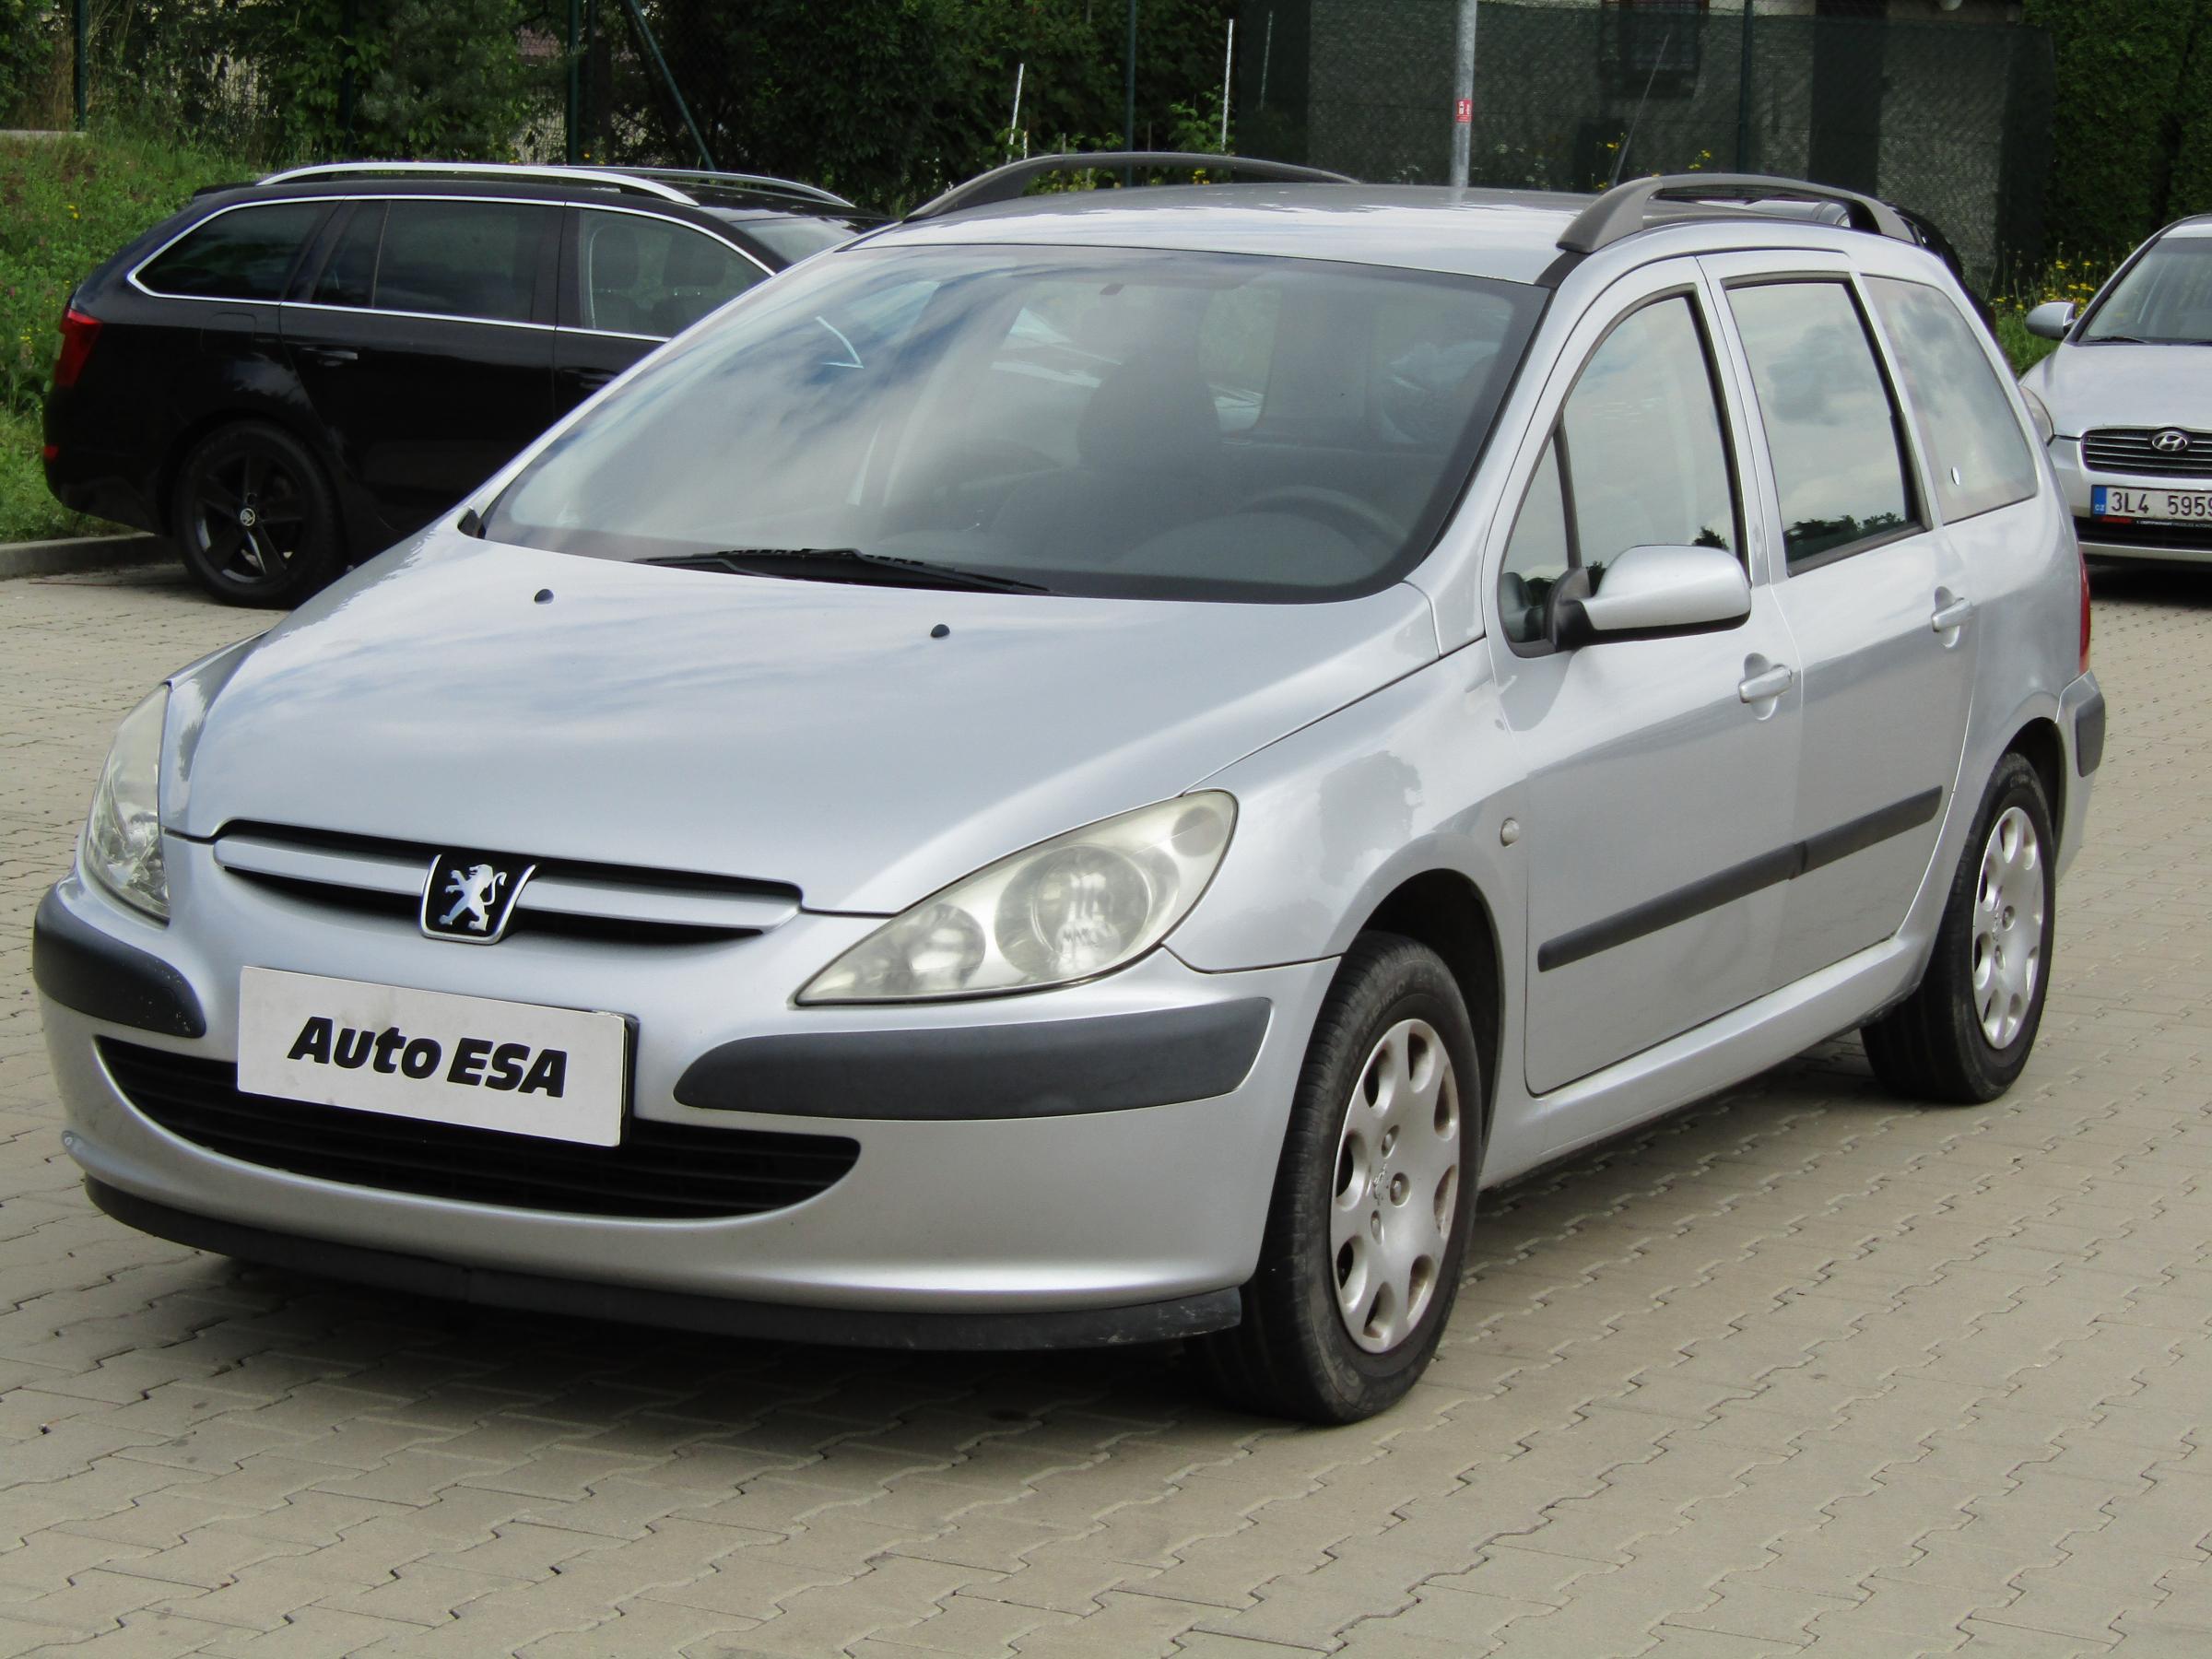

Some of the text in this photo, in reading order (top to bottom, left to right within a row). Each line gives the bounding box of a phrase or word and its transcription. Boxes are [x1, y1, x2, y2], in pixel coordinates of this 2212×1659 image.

[2095, 503, 2105, 512] CZ
[2112, 491, 2149, 514] 3L4
[287, 1016, 568, 1099] Auto ESA
